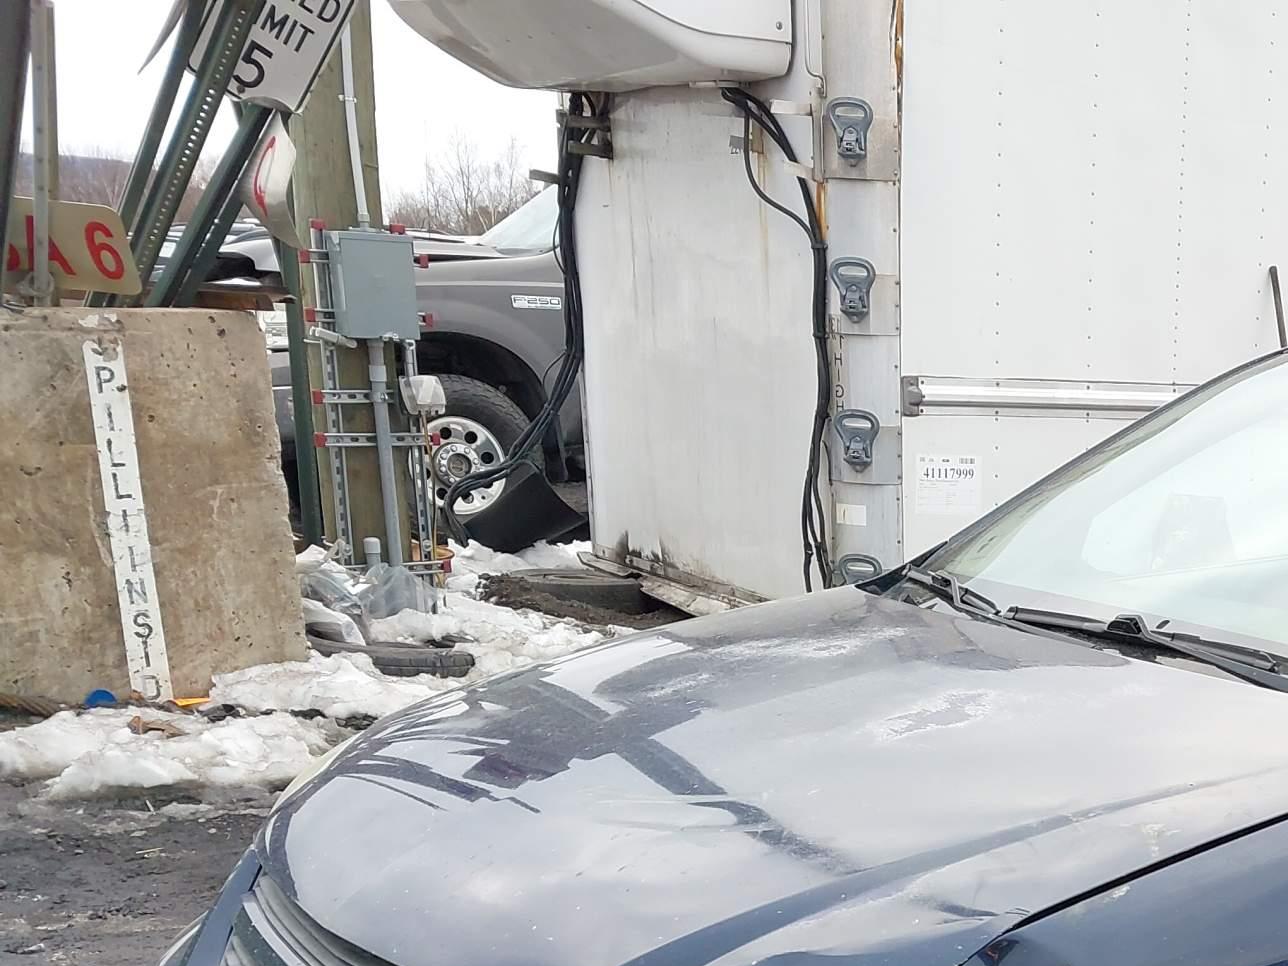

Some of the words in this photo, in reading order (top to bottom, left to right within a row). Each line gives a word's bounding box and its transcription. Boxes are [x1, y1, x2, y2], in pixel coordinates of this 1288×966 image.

[260, 4, 315, 53] MIT
[85, 221, 125, 280] 6
[922, 466, 976, 480] 41117999
